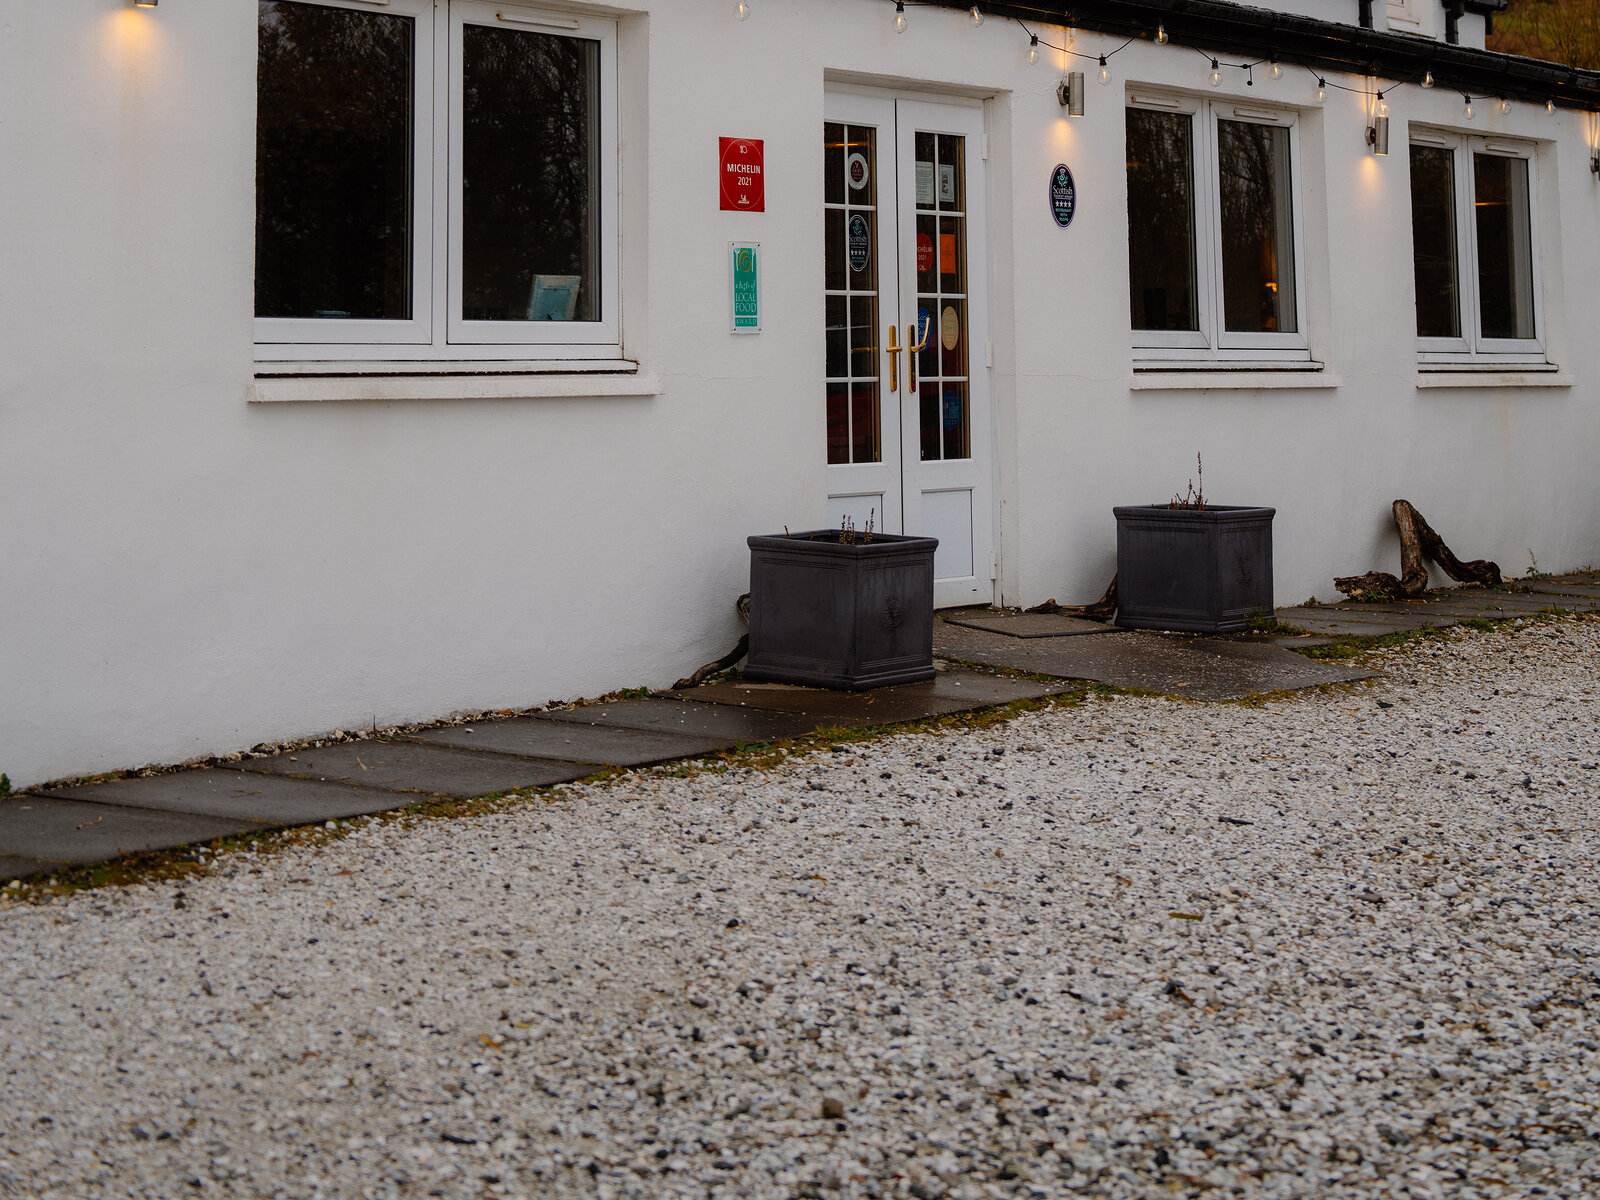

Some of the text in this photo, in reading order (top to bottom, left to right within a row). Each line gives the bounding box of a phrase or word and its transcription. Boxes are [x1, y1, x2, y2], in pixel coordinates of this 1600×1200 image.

[727, 163, 761, 174] MICHELIN
[737, 176, 752, 186] 2021
[1053, 184, 1073, 195] Scottish
[735, 292, 756, 302] LOCAL
[735, 302, 757, 313] FOOD
